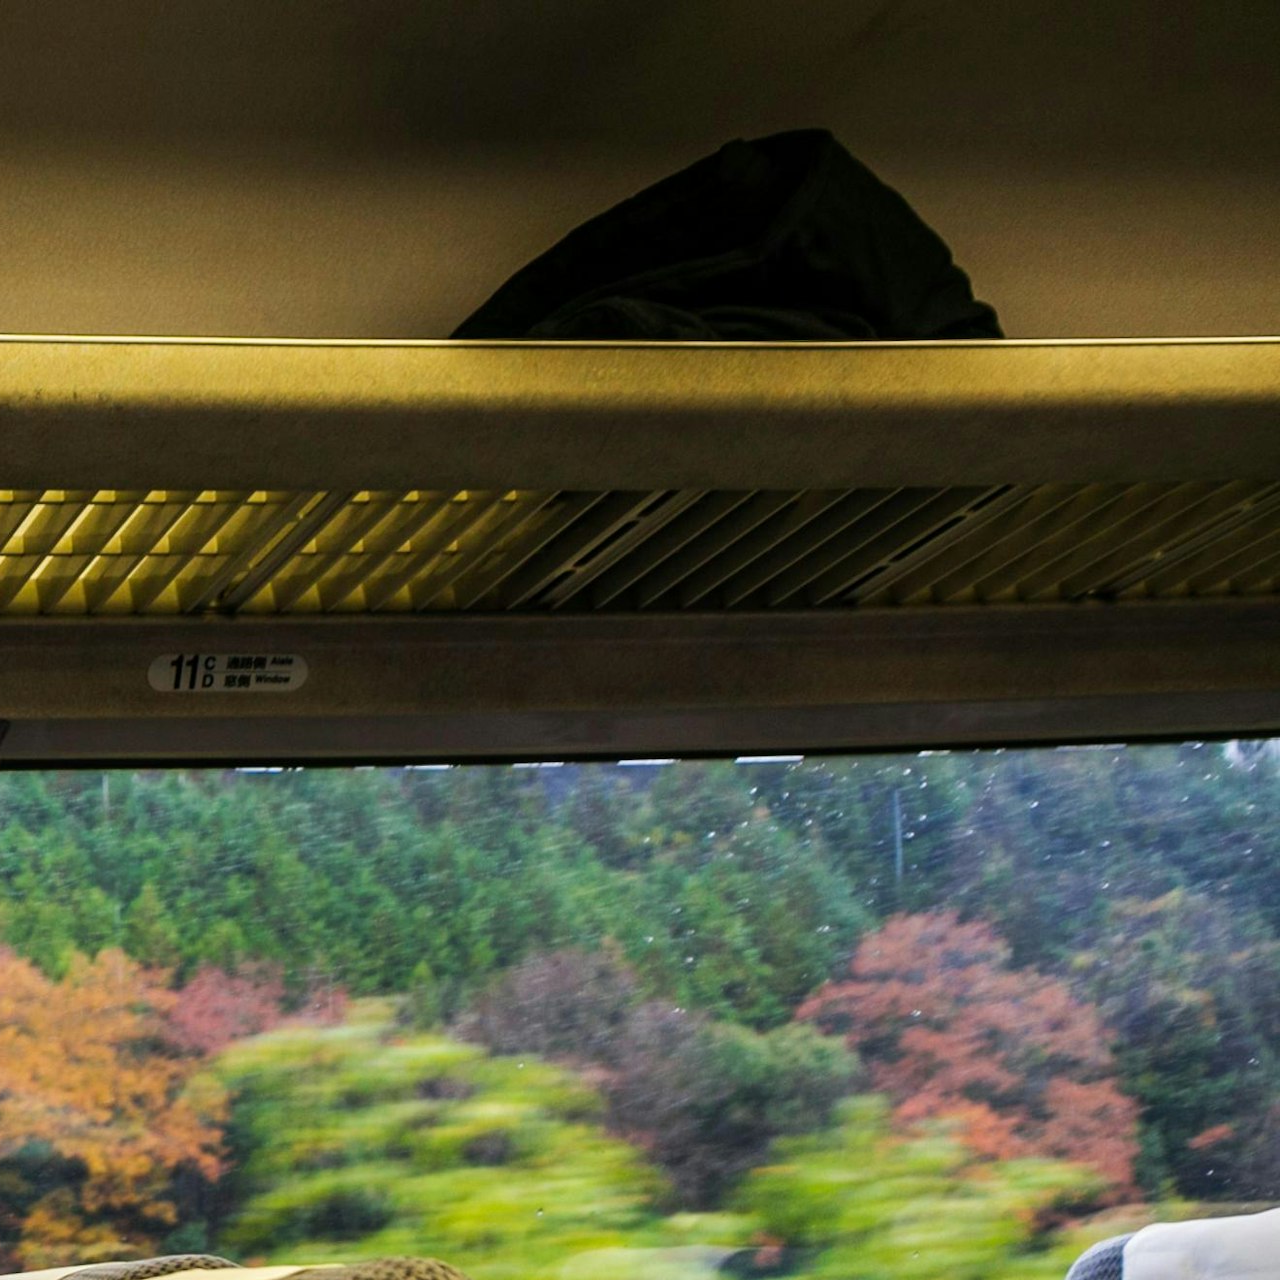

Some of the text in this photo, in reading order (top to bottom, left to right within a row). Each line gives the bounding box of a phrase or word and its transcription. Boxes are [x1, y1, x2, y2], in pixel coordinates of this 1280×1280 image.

[204, 656, 216, 670] C
[171, 654, 199, 689] 11
[202, 675, 214, 688] D
